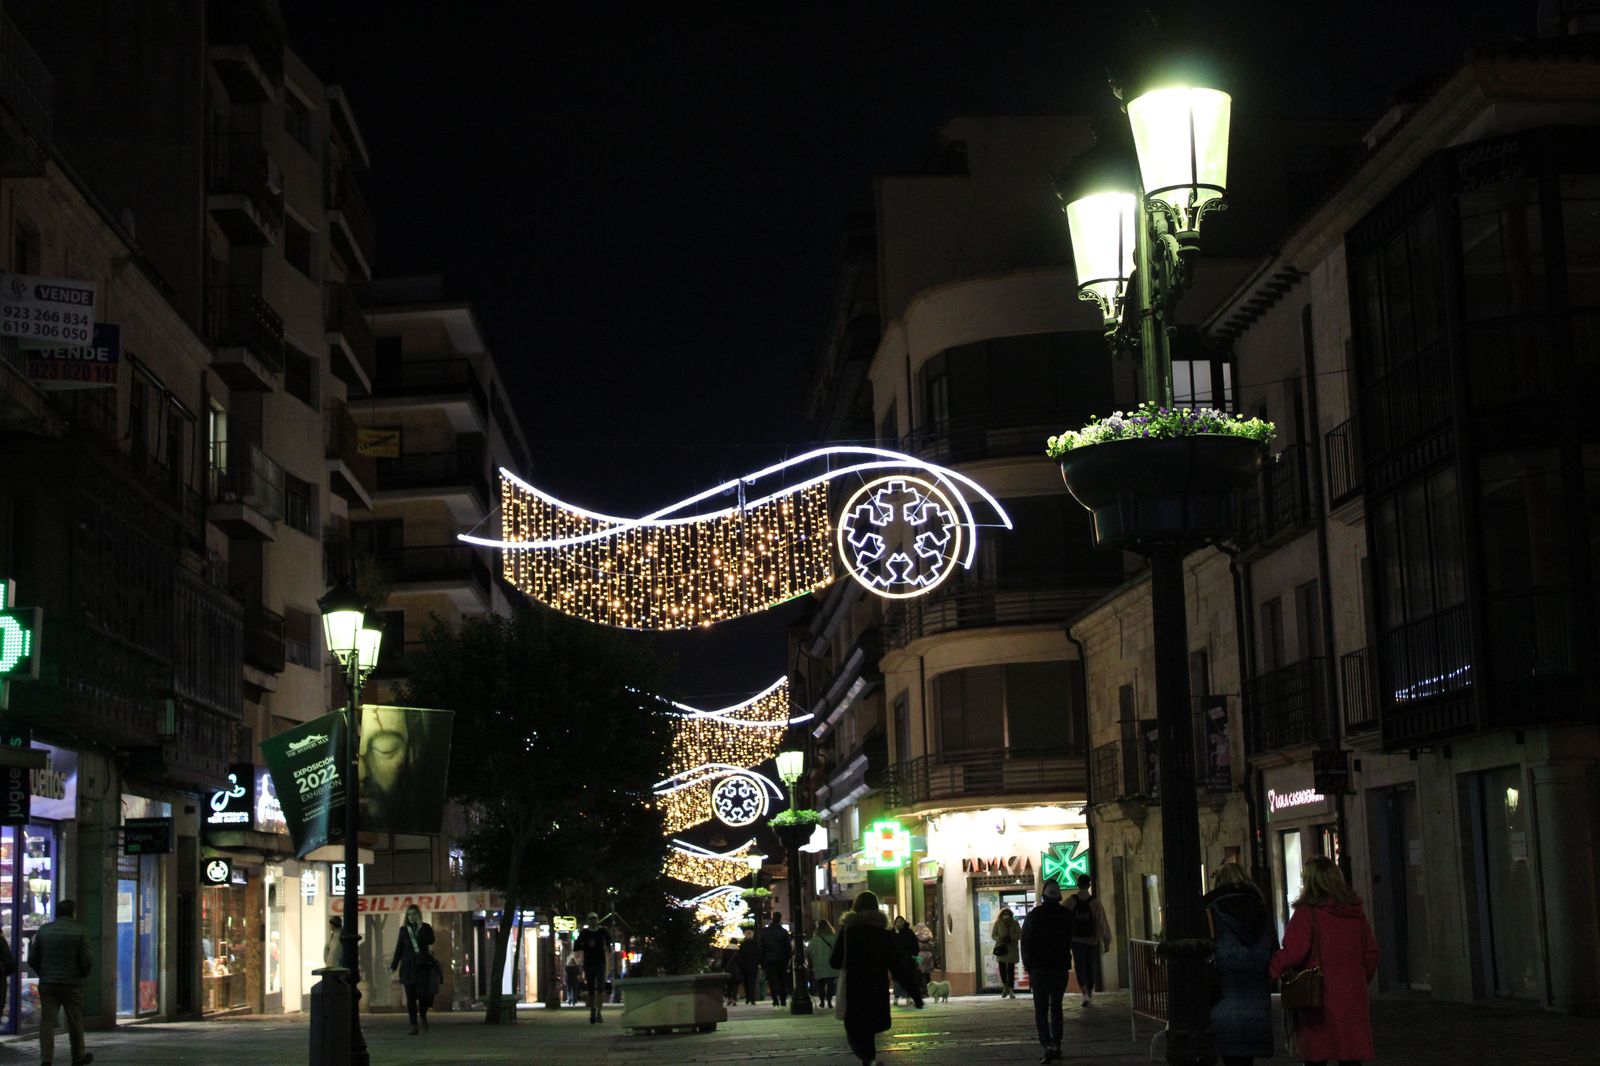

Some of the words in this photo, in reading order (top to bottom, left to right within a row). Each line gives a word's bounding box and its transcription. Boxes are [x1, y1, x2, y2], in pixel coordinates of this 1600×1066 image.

[40, 287, 90, 304] VENDE
[4, 305, 30, 319] 923
[33, 309, 60, 323] 266
[63, 312, 88, 327] 834
[3, 320, 30, 333] 619
[33, 323, 60, 337] 306
[62, 327, 88, 341] 050
[40, 347, 109, 361] VENDE
[293, 755, 335, 779] EXPOSICIÓN
[296, 764, 339, 794] 2022
[300, 779, 342, 803] EXHIBITION
